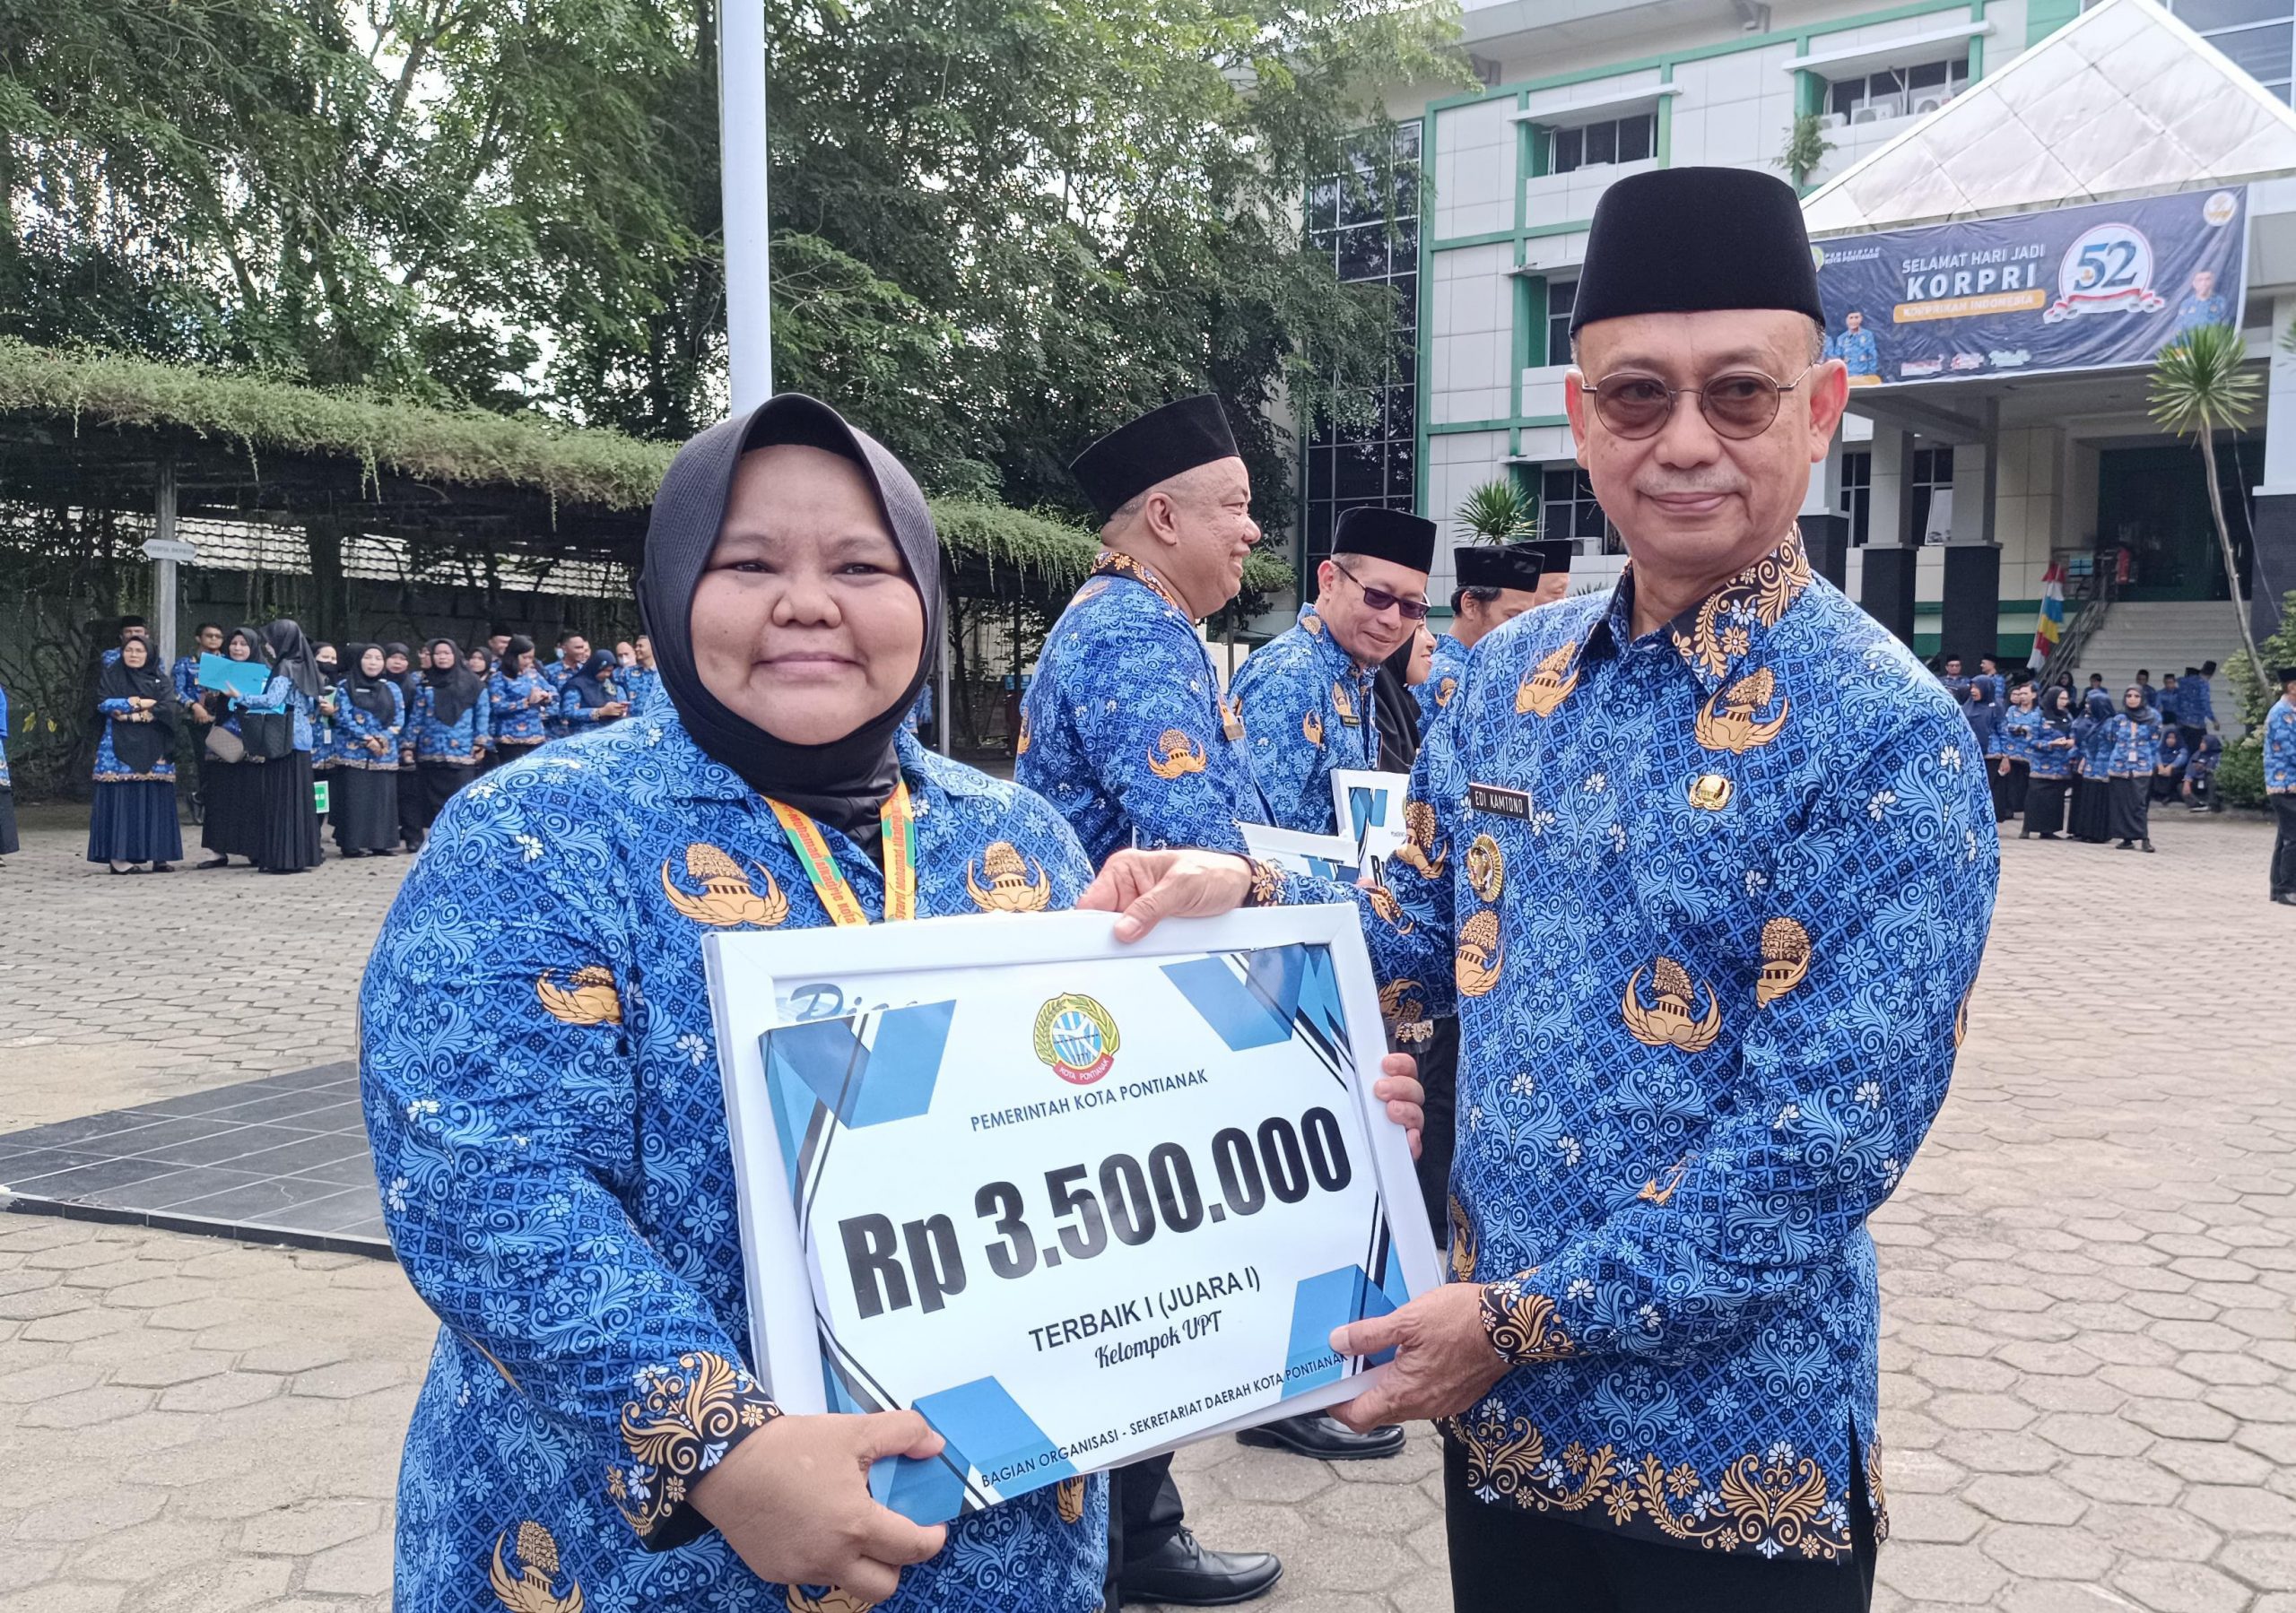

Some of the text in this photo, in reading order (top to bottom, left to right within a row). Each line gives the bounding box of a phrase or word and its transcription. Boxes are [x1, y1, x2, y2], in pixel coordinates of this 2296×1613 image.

[1901, 244, 2046, 274] SELAMAT HARI JADI
[1907, 263, 2037, 301] KORPRI
[2074, 240, 2137, 292] 52
[1474, 790, 1524, 814] EDI KAMTONO
[970, 1069, 1209, 1132] PEMERINTAH KOTA PONTIANAK
[1059, 1066, 1076, 1080] KOTA
[838, 1106, 1352, 1320] Rp 3.500.000
[1029, 1266, 1260, 1352] TERBAIK I (JUARA I)
[1094, 1310, 1222, 1368] Kelompok UPT
[981, 1460, 1036, 1488] BAGIAN
[1039, 1429, 1119, 1467] ORGANISASI
[1129, 1400, 1203, 1435] SEKRETARIAT
[1205, 1383, 1252, 1409] DAERAH
[1255, 1372, 1284, 1392] KOTA
[1285, 1354, 1348, 1382] PONTIANAK
